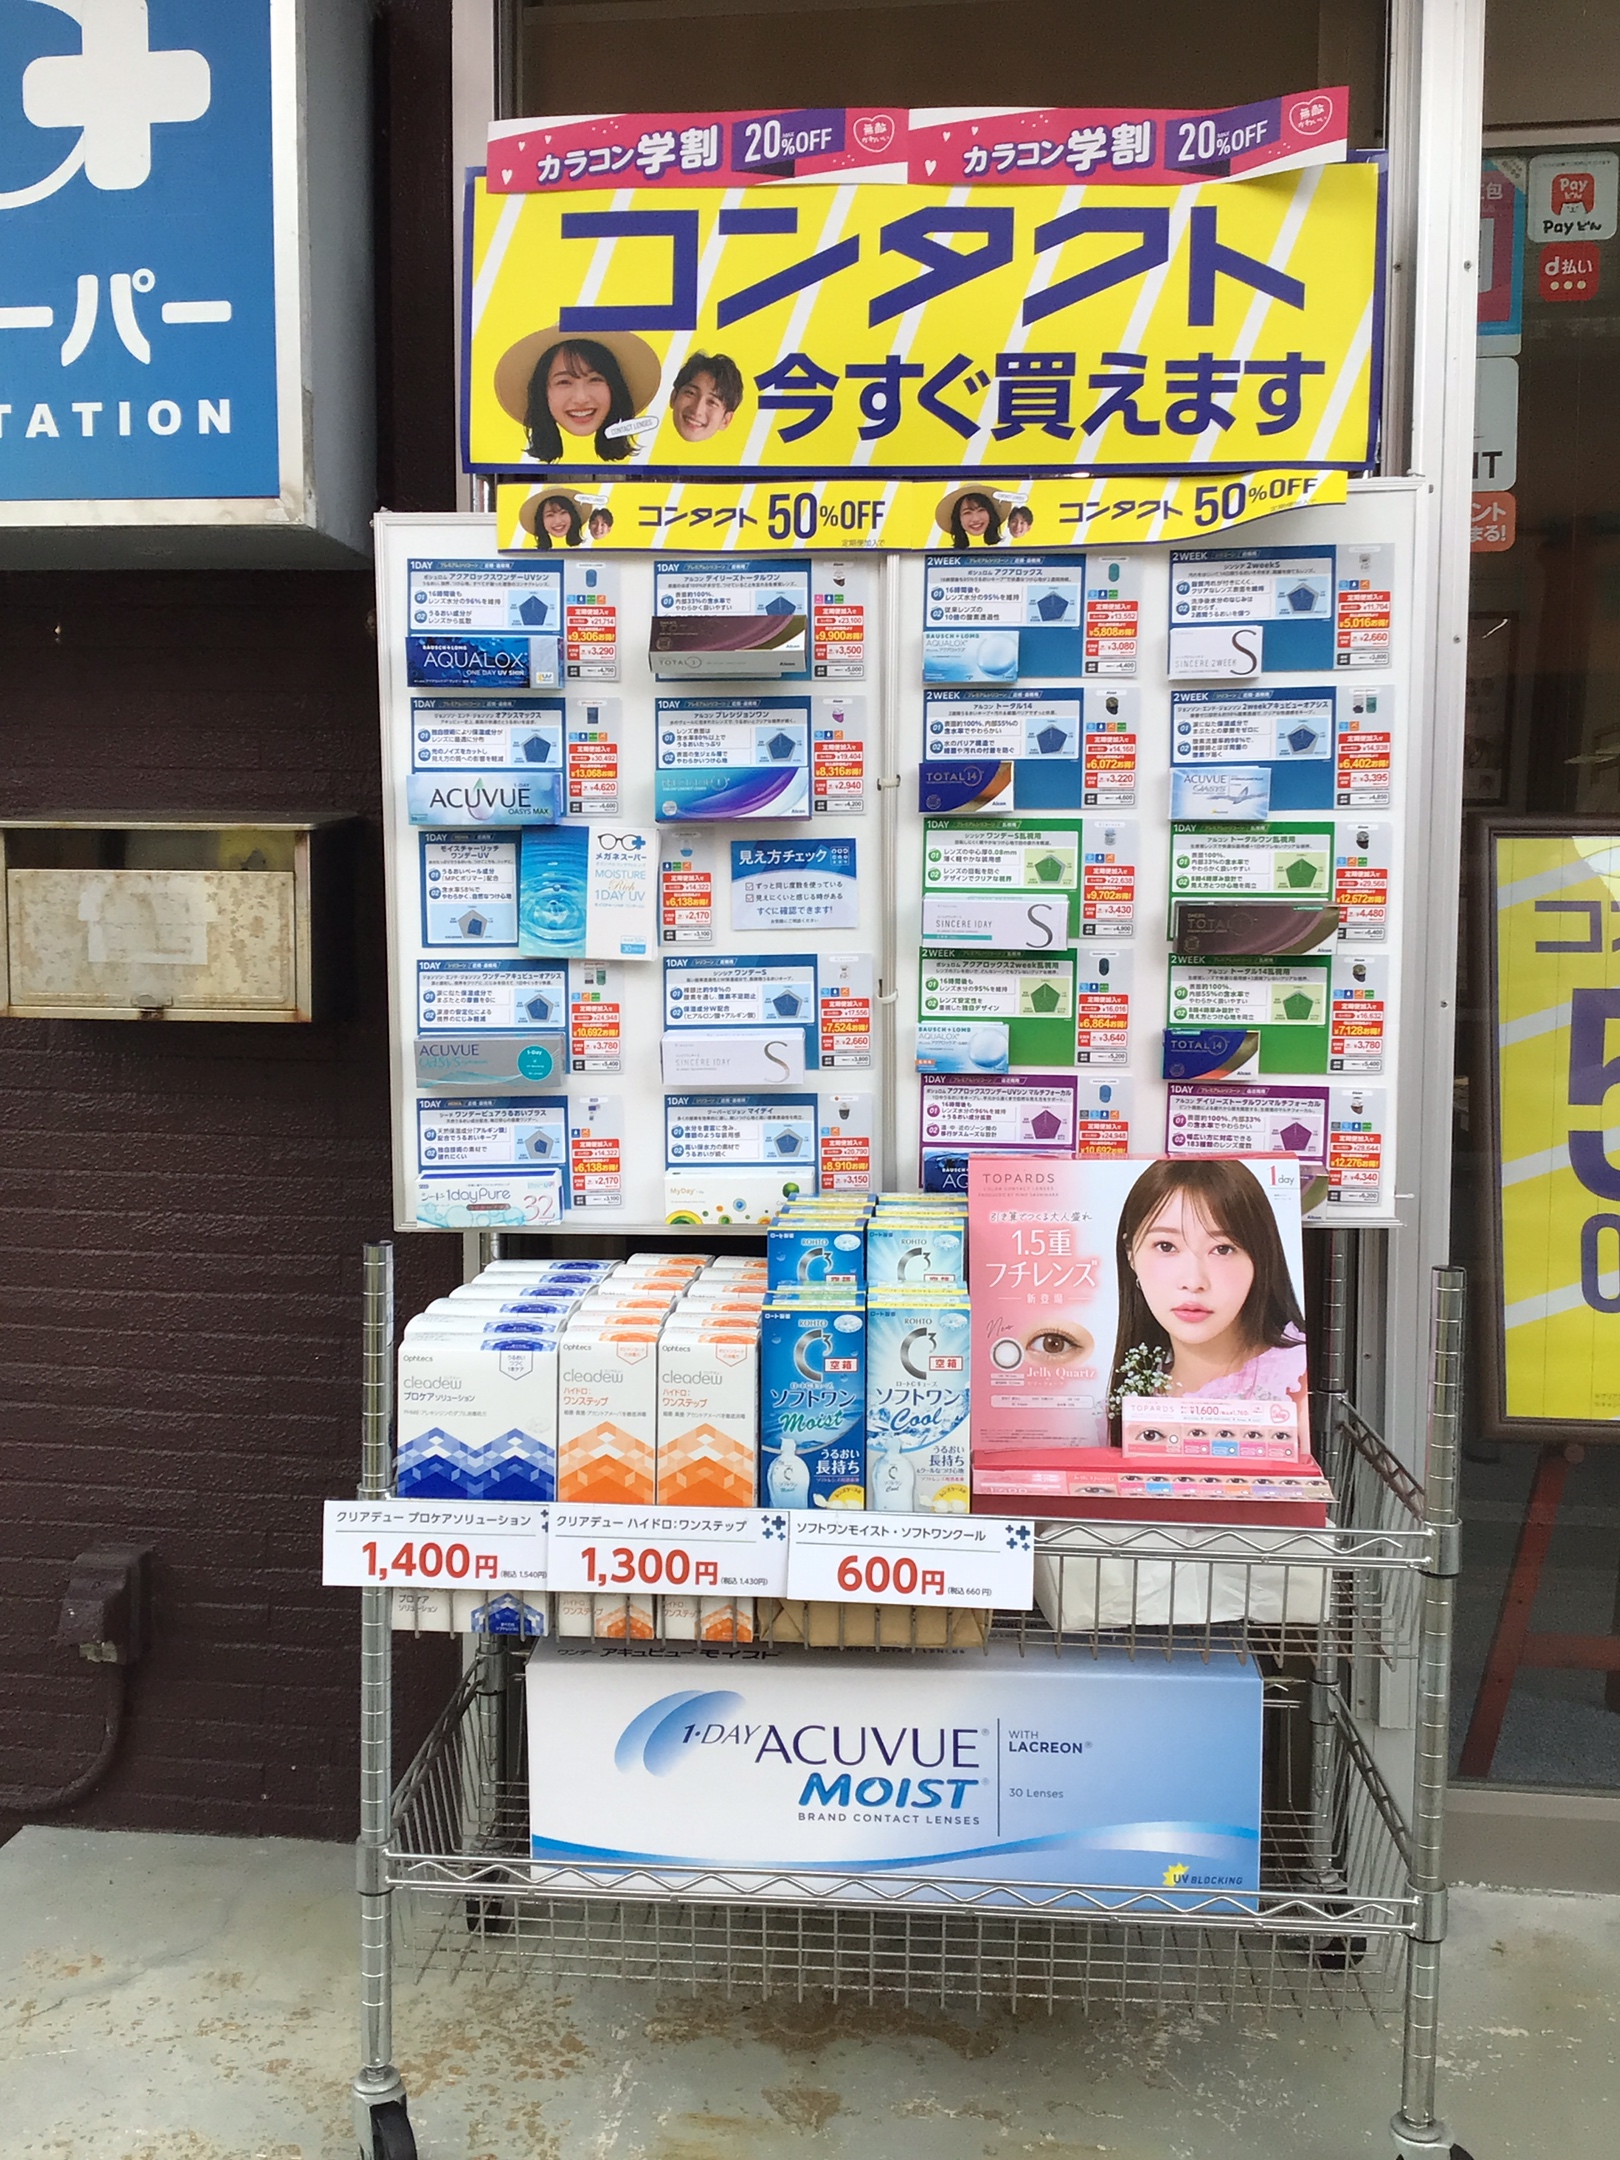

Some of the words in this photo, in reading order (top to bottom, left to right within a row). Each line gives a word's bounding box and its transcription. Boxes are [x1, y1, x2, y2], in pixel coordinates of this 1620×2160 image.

[1560, 178, 1588, 192] Pay
[559, 206, 1305, 332] コンタクト
[1544, 256, 1593, 276] d払い
[754, 352, 1325, 443] 今すぐ買えます
[638, 506, 758, 528] コンタクト
[1059, 500, 1183, 524] コンタクト
[927, 557, 961, 565] 2WEEK
[1172, 551, 1208, 561] 2WEEK
[410, 561, 433, 569] 1DAY
[657, 564, 680, 572] 1DAY
[1229, 629, 1258, 676] S
[424, 652, 523, 668] AQUALOX
[926, 691, 960, 700] 2WEEK
[1173, 693, 1208, 702] 2WEEK
[413, 700, 435, 708] 1DAY
[658, 700, 681, 709] 1DAY
[926, 772, 962, 781] TOTAL
[1183, 774, 1226, 784] ACUVUE
[430, 788, 532, 808] ACUVUE
[927, 820, 950, 829] 1DAY
[1173, 824, 1197, 832] 1DAY
[425, 833, 447, 842] 1DAY
[595, 853, 647, 862] メガネスーパー
[739, 849, 827, 866] 見え方チェック
[595, 869, 646, 880] MOISTURE
[595, 889, 626, 901] 1DAY
[628, 890, 646, 901] UV
[1025, 903, 1053, 949] S
[922, 949, 955, 957] 2WEEK
[665, 959, 688, 967] 1DAY
[1171, 955, 1205, 964] 2WEEK
[419, 962, 441, 970] 1DAY
[1171, 1039, 1210, 1050] TOTAL
[419, 1044, 479, 1057] ACUVUE
[764, 1041, 790, 1084] S
[923, 1075, 946, 1084] 1DAY
[1170, 1085, 1193, 1093] 1DAY
[419, 1100, 441, 1108] 1DAY
[667, 1097, 689, 1105] 1DAY
[982, 1173, 1055, 1184] TOPARDS
[523, 1194, 556, 1222] 32
[1011, 1228, 1073, 1257] 1.5重
[985, 1260, 1098, 1288] フチレンズ
[1027, 1293, 1064, 1304] 新登場
[904, 1317, 933, 1326] ROHTO
[563, 1344, 592, 1352] Ophtecs
[662, 1345, 691, 1353] Ophtecs
[829, 1360, 853, 1370] 空箱
[935, 1358, 958, 1369] 空箱
[563, 1370, 624, 1384] cleadew
[662, 1371, 723, 1385] cleadew
[1027, 1366, 1052, 1382] Jelly
[1055, 1367, 1095, 1380] Quartz
[403, 1376, 462, 1390] cleadew
[403, 1391, 476, 1402] プロケアソリューション
[563, 1396, 609, 1406] ワンステップ
[771, 1389, 857, 1408] ソフトワン
[876, 1387, 962, 1407] ソフトワン
[662, 1398, 708, 1408] ワンステップ
[1131, 1404, 1175, 1413] TOPARDS
[780, 1409, 844, 1434] Moist
[890, 1407, 943, 1433] Cool
[821, 1448, 860, 1459] うるおい
[933, 1445, 966, 1455] うるおい
[929, 1454, 965, 1467] 長持ち
[815, 1460, 861, 1475] 長持ち
[337, 1511, 404, 1522] クリアデュー
[408, 1512, 532, 1527] プロケアソリューション
[556, 1515, 624, 1528] クリアデュー
[627, 1518, 748, 1533] ハイドロ:ワンステップ
[796, 1522, 986, 1541] ソフトワンモイスト・ソフトワンクール
[362, 1541, 498, 1581] 1,400円
[581, 1547, 718, 1587] 1,300円
[837, 1554, 945, 1596] 600円
[600, 1647, 694, 1659] アキュビュー
[699, 1649, 779, 1661] モイスト
[1008, 1730, 1039, 1740] WITH
[1008, 1741, 1083, 1754] LACREON
[1009, 1788, 1023, 1798] 30
[1026, 1788, 1064, 1799] Lenses
[798, 1811, 848, 1823] BRAND
[852, 1812, 920, 1824] CONTACT
[925, 1814, 981, 1826] LENSES
[1172, 1873, 1189, 1884] UV
[1190, 1876, 1243, 1885] BLOCKING
